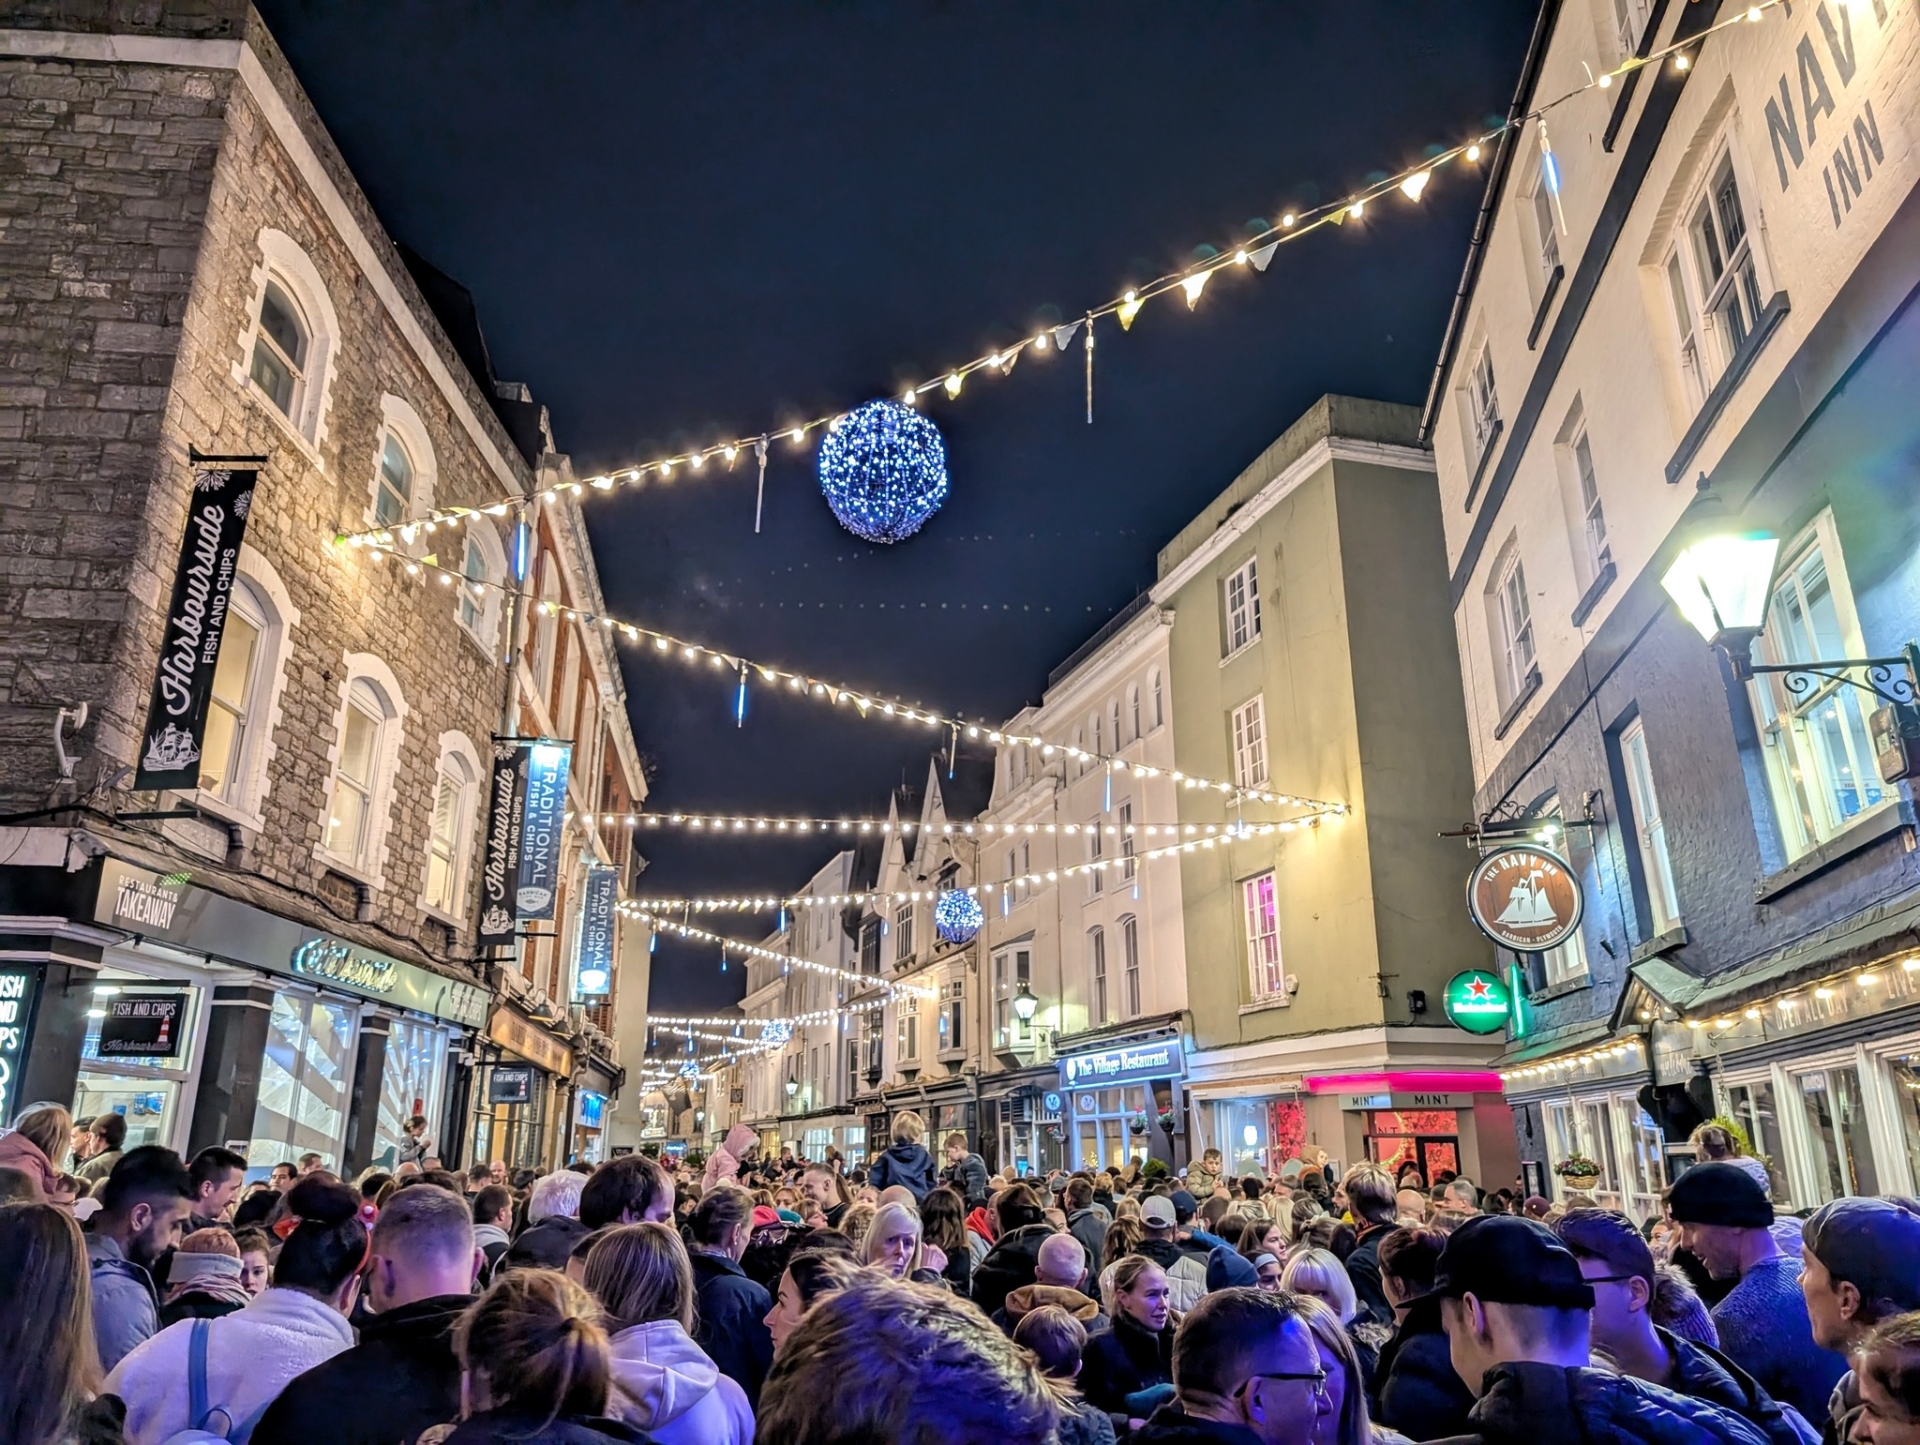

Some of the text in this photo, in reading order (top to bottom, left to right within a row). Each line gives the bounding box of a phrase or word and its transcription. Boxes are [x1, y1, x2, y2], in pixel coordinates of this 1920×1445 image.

[1764, 0, 1888, 193] NAV
[1823, 98, 1884, 229] INN
[160, 504, 225, 716] Harbourside
[202, 547, 236, 664] FISH AND CHIPS
[530, 780, 541, 808] FISH
[485, 768, 515, 901] Harbourside
[508, 796, 523, 869] FISH AND CHIPS
[532, 758, 559, 884] TRADITIONAL
[524, 825, 536, 862] CHIPS
[1484, 853, 1559, 882] THE NAVY INN
[115, 886, 177, 930] TAKEAWAY
[591, 894, 599, 914] FISH
[587, 925, 596, 952] CHIPS
[593, 879, 611, 968] TRADITIONAL
[1501, 925, 1564, 943] BARBICAN PLYMOUTH
[112, 1002, 177, 1016] FISH AND CHIPS
[493, 1074, 504, 1082] FISH
[1077, 1048, 1169, 1077] The Village Restaurant
[1352, 1096, 1375, 1106] MINT
[1414, 1095, 1449, 1105] MINT
